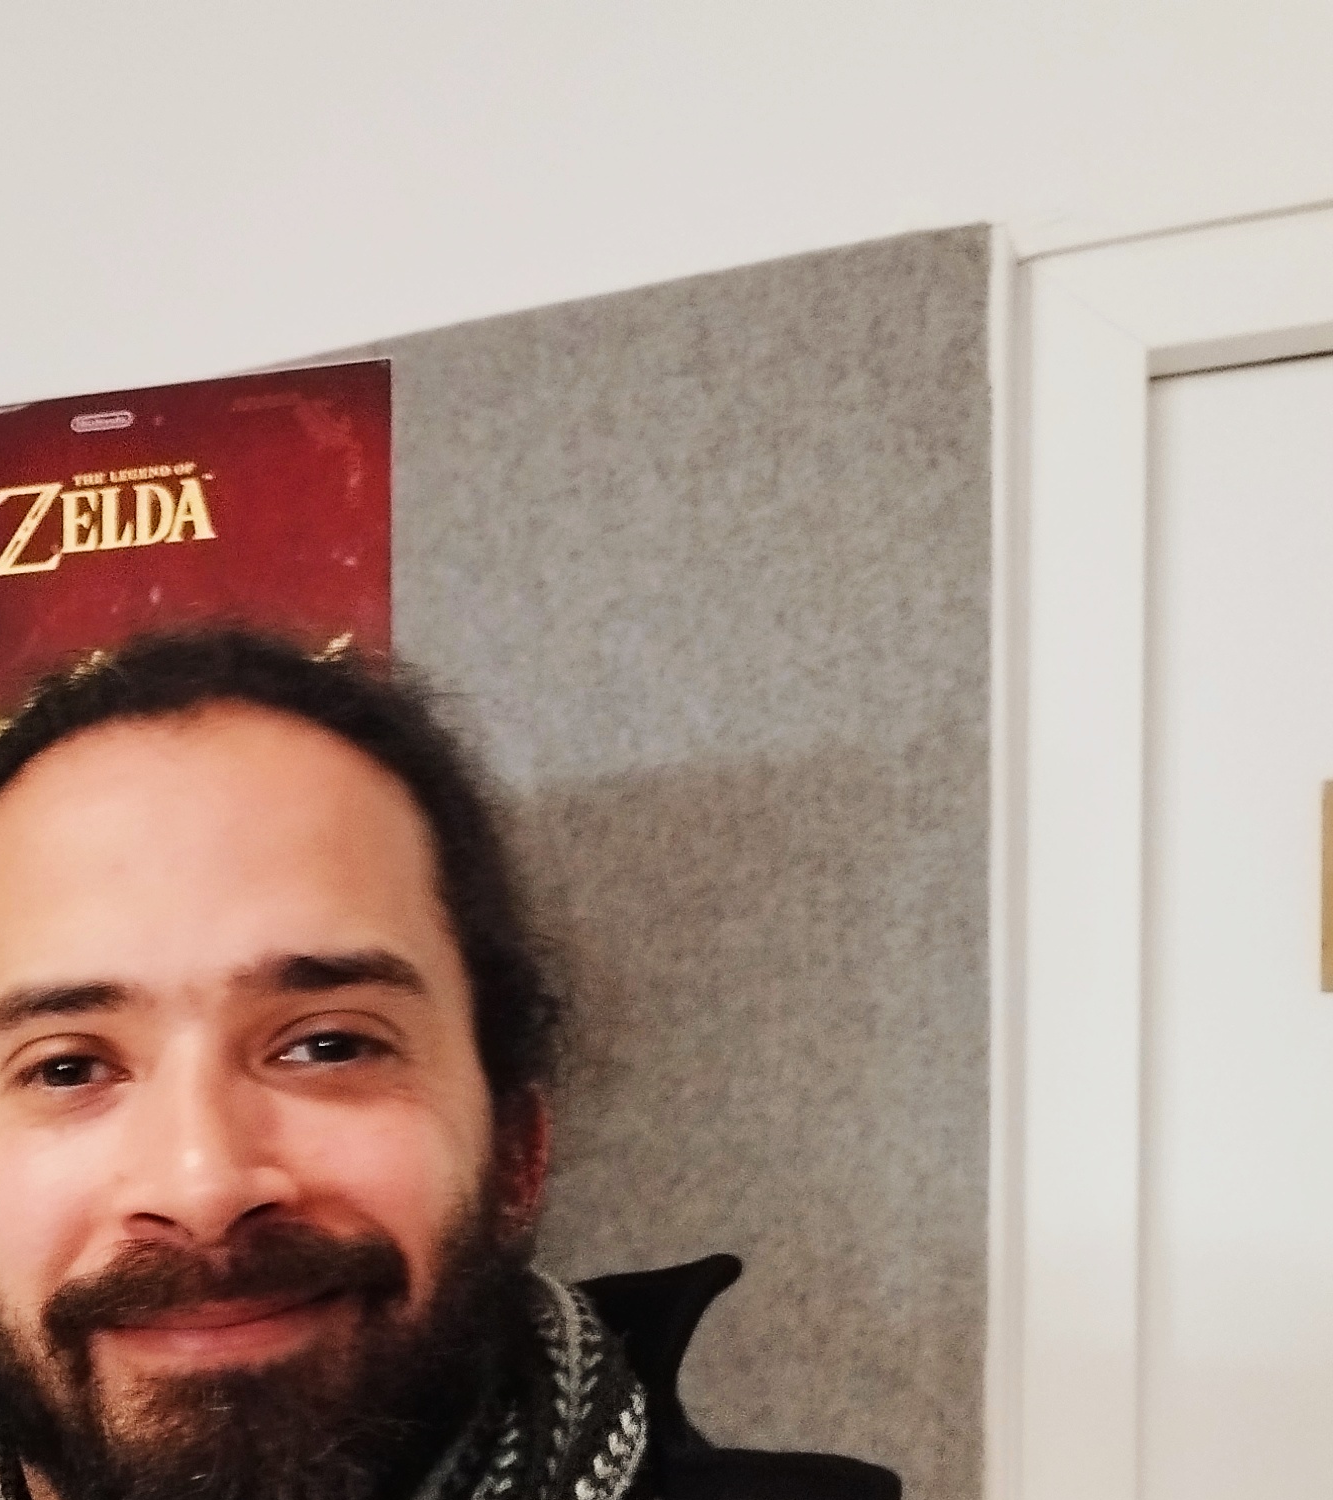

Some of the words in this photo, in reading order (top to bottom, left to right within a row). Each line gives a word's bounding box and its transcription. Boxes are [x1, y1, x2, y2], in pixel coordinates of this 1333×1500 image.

[72, 472, 106, 487] THE
[109, 465, 172, 484] LEGEND
[174, 461, 197, 476] OF
